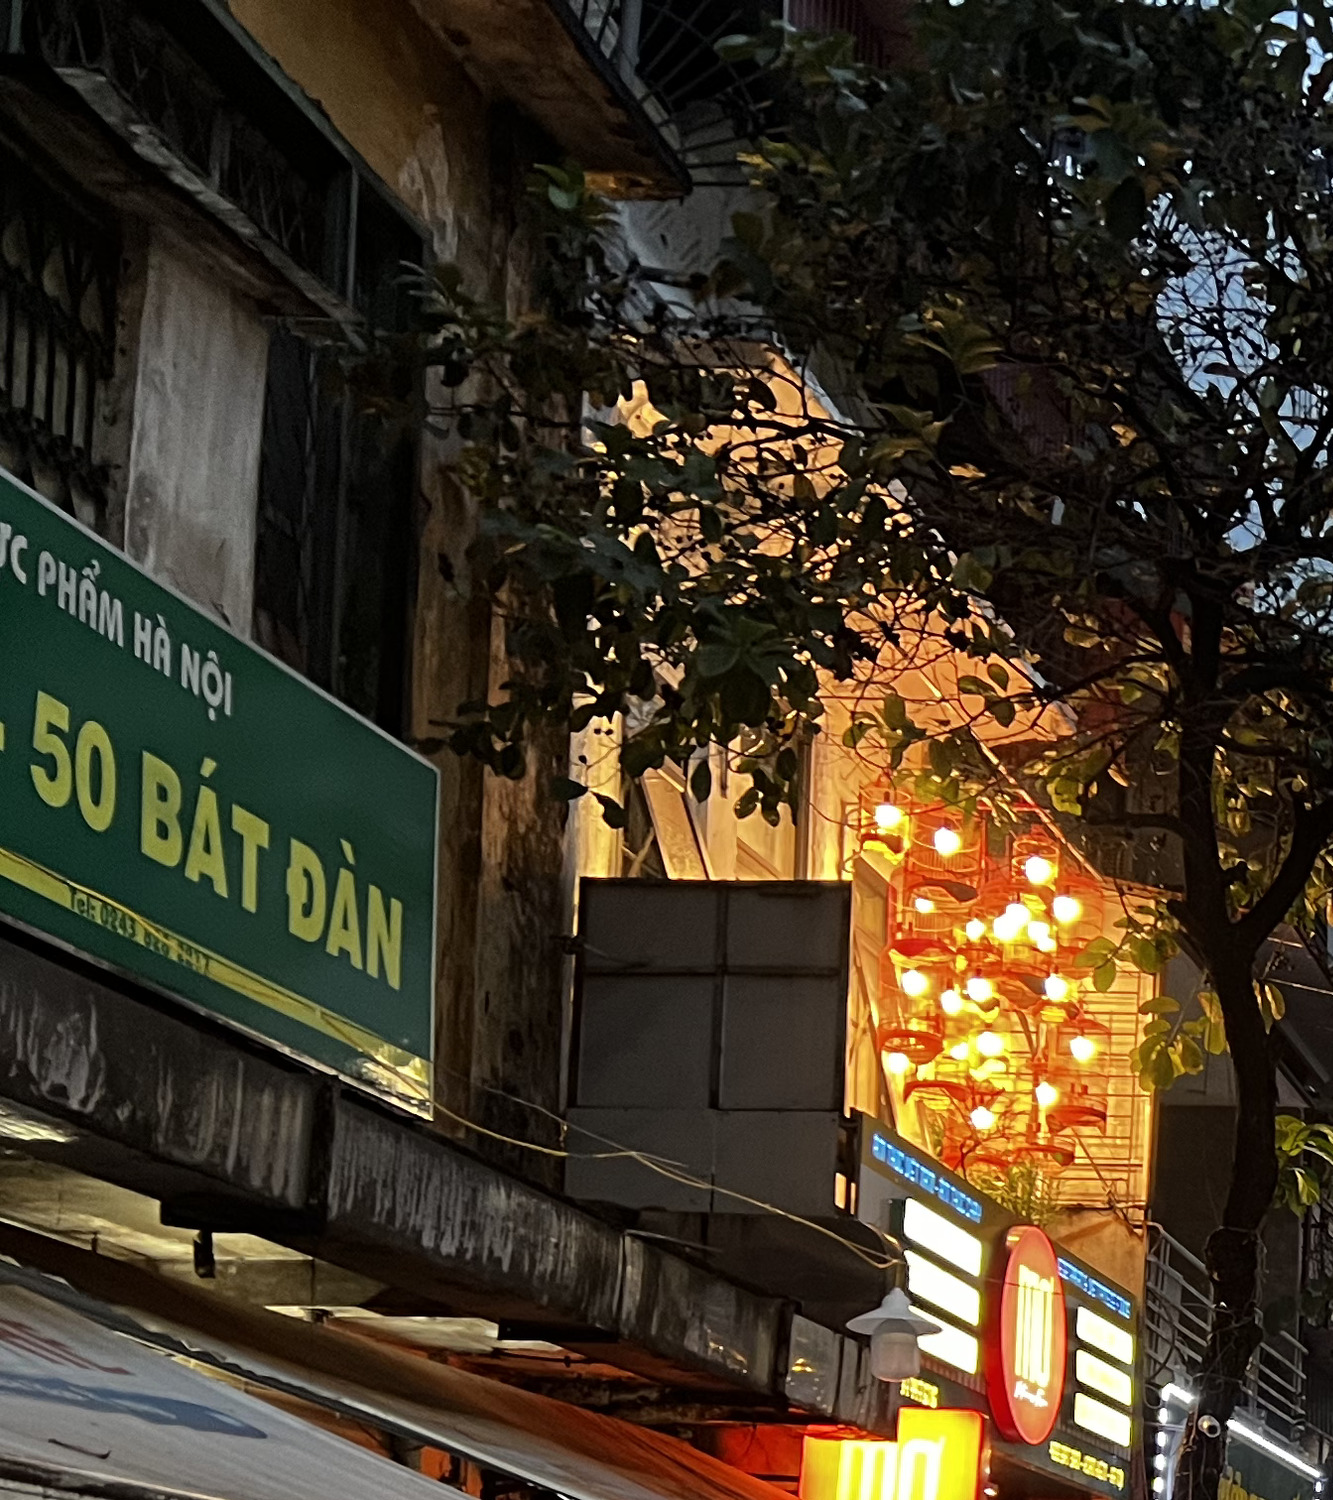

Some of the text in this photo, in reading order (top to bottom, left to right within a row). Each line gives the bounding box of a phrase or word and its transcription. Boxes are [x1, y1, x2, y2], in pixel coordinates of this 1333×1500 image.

[132, 612, 171, 677] HÀ
[181, 650, 232, 720] NỘI
[30, 690, 403, 990] 50 BÁT ĐÀN
